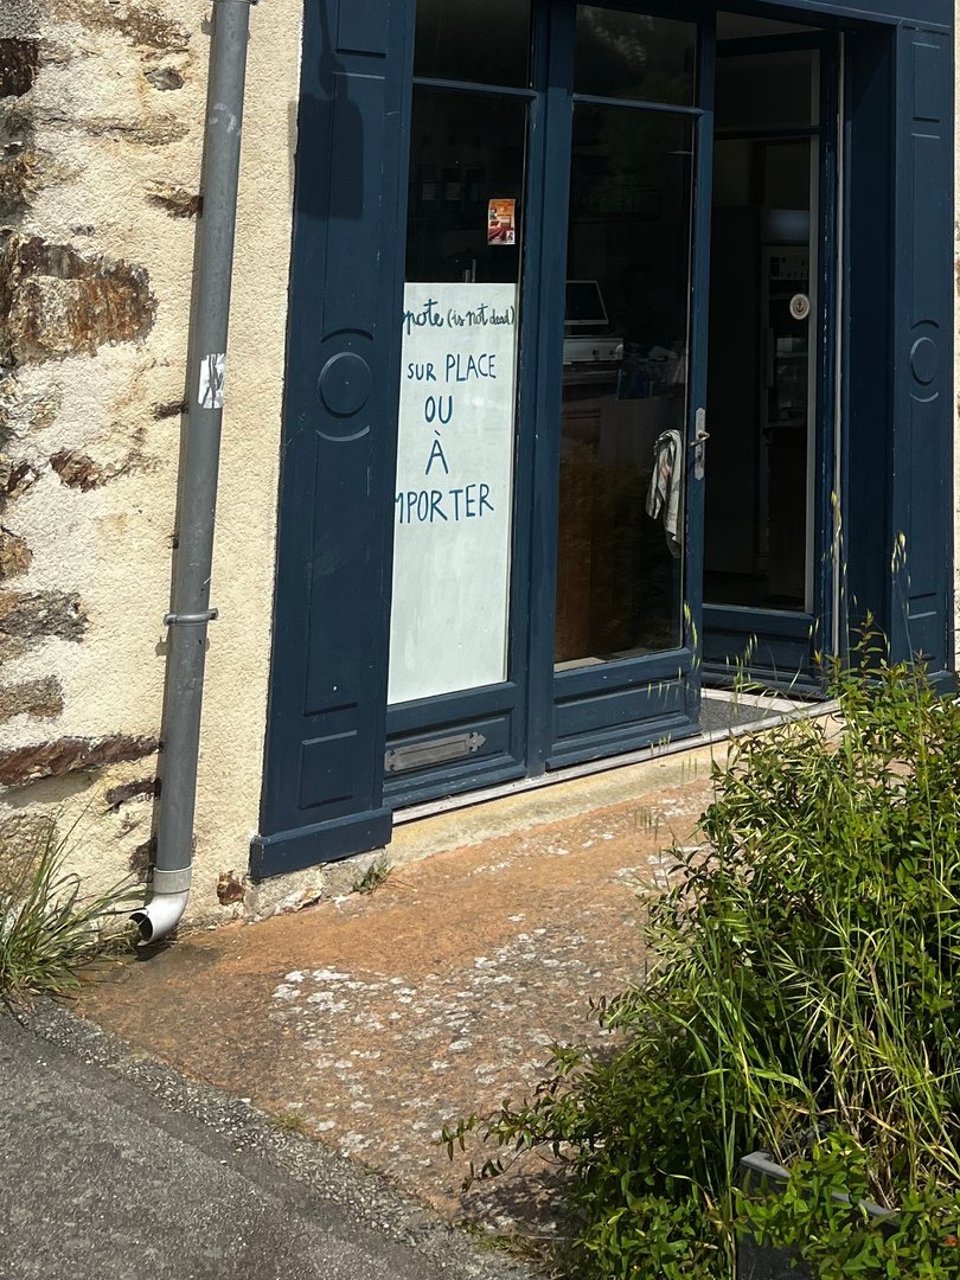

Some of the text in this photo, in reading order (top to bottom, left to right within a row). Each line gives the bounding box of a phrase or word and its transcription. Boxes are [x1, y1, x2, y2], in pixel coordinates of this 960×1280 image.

[465, 303, 489, 327] not
[407, 353, 496, 382] SUR PLACE
[424, 395, 453, 424] OU
[425, 429, 449, 475] À
